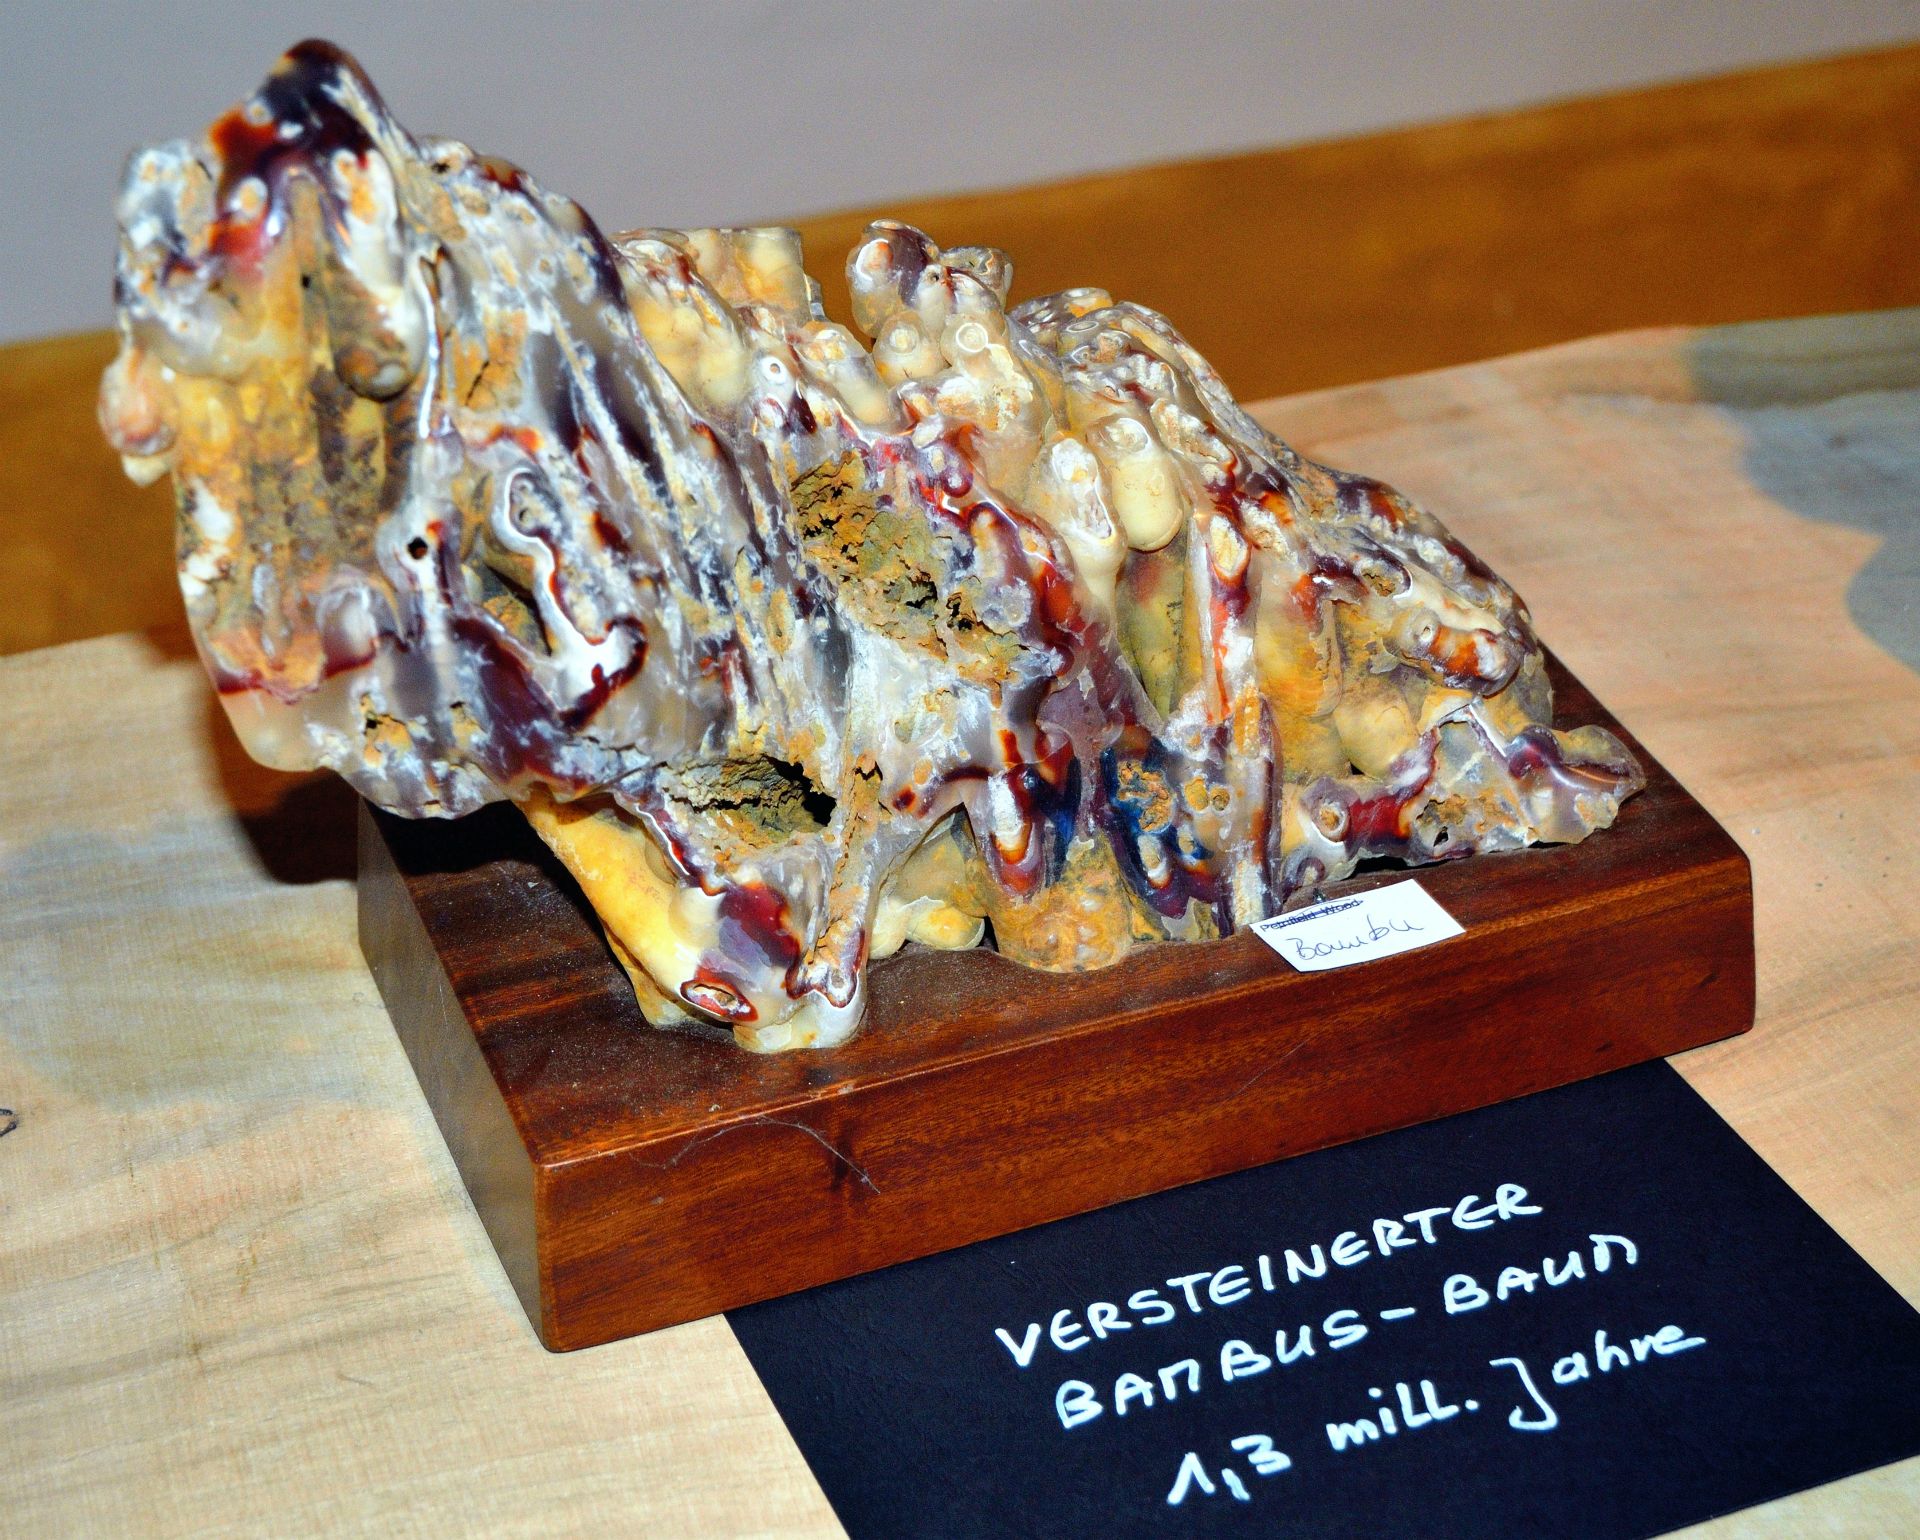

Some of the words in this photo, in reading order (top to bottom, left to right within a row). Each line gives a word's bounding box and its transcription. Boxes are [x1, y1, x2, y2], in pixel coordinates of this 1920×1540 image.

[994, 1183, 1543, 1367] VERSTEINERTER
[1166, 1434, 1292, 1505] 1,3
[1488, 1324, 1707, 1431] Jahre
